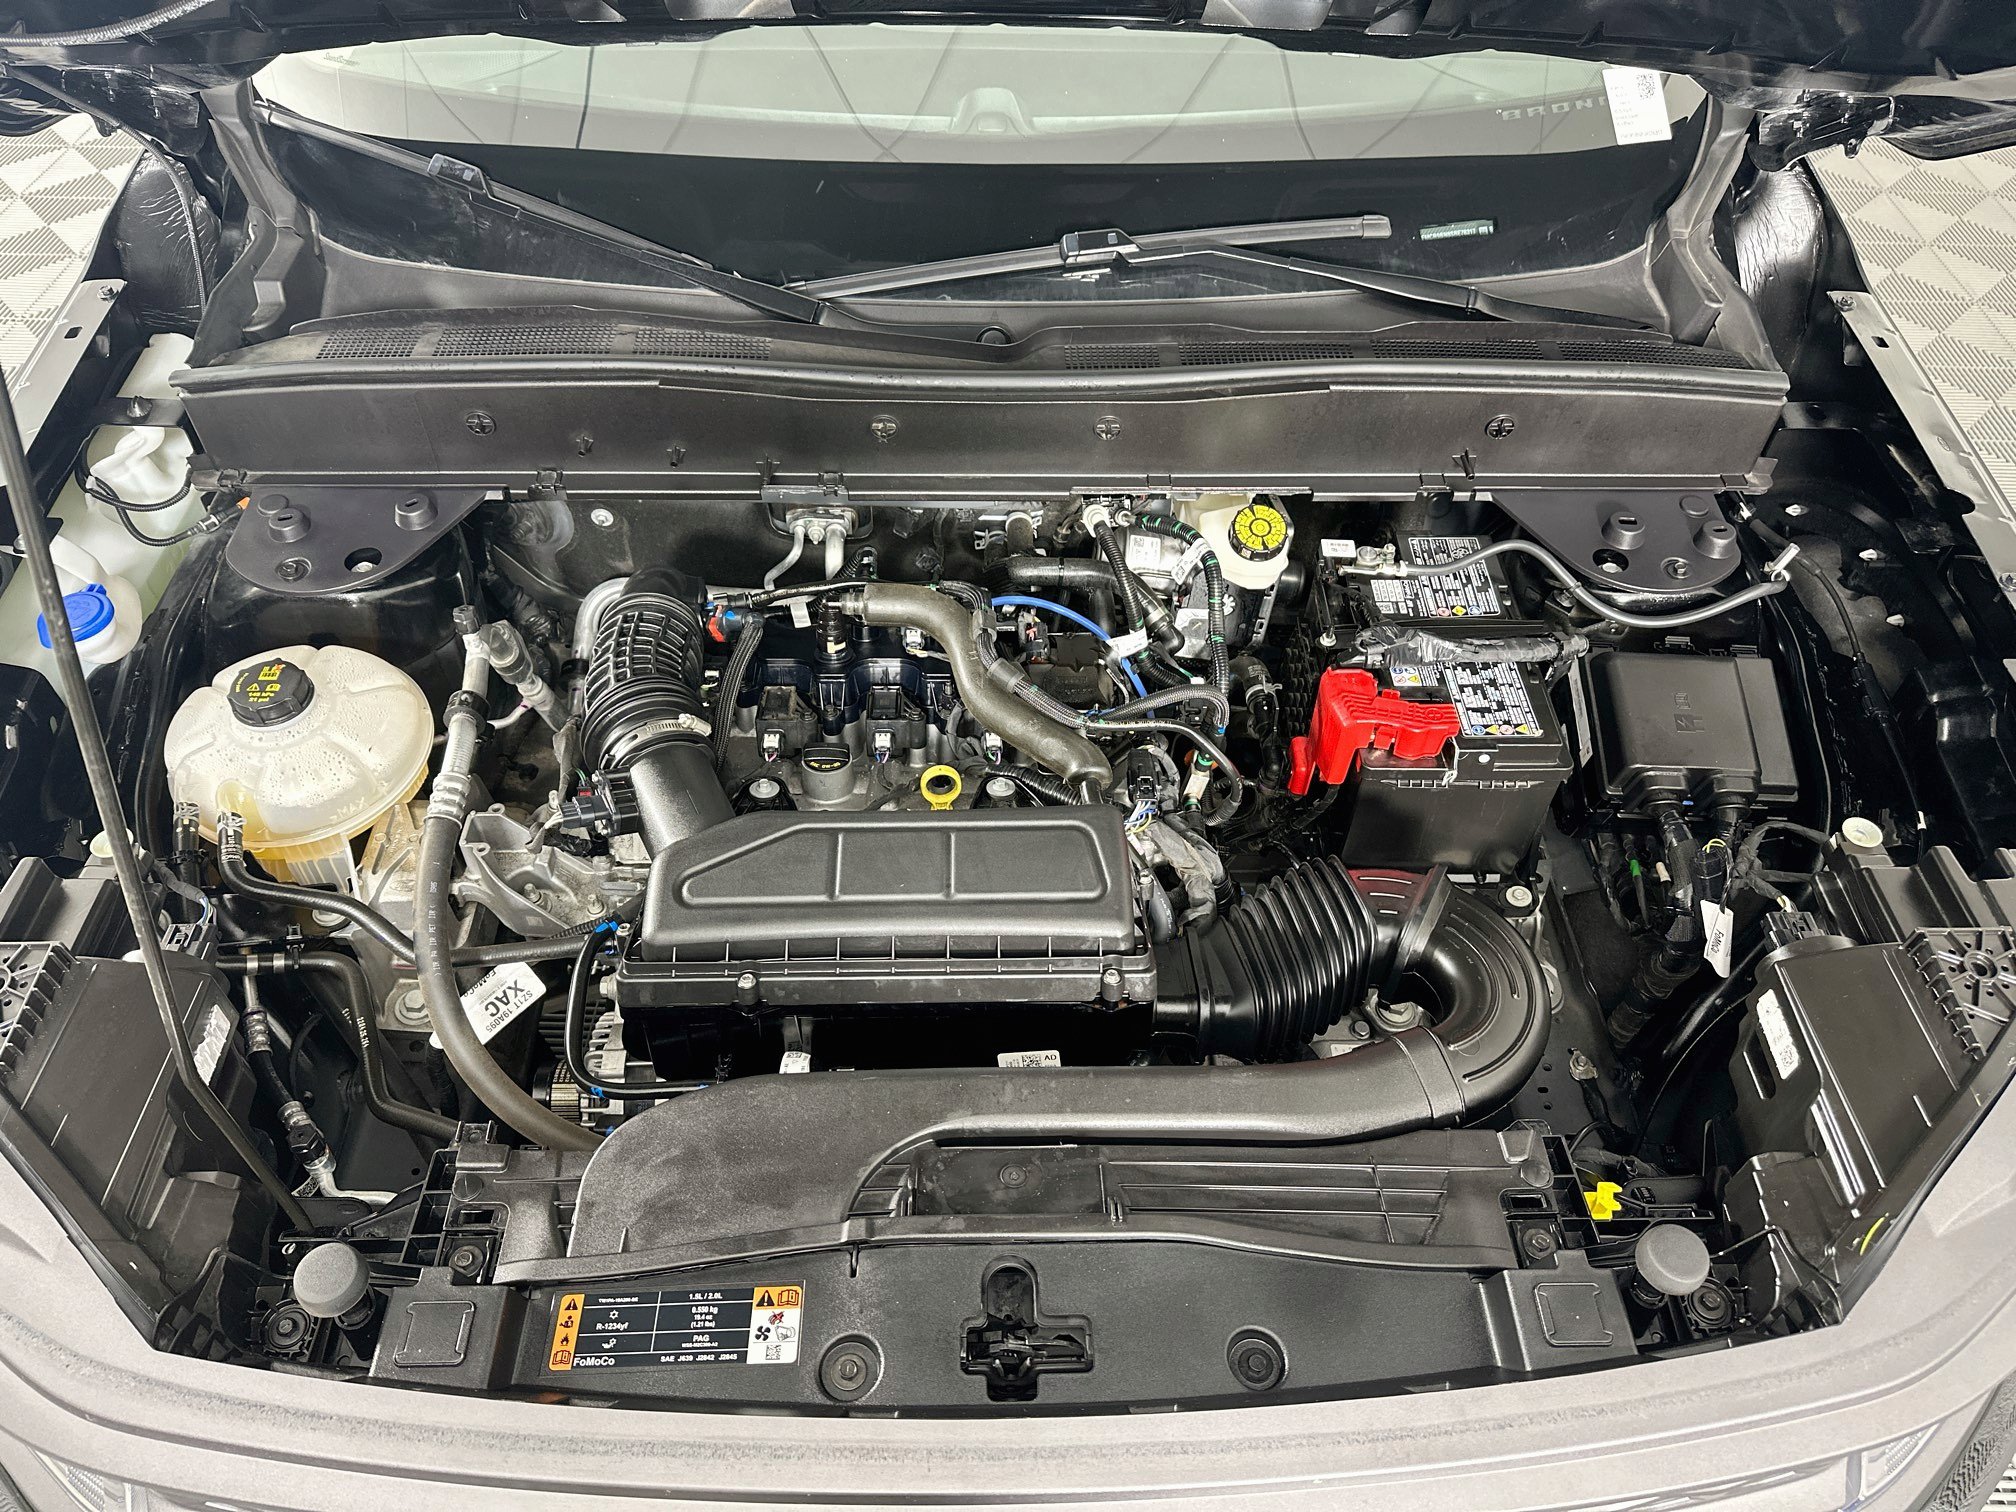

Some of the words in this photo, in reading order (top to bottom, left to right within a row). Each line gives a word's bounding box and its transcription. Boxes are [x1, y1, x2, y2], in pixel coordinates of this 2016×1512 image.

[484, 980, 525, 1017] XAC
[514, 990, 533, 1010] SZ1T
[485, 1008, 513, 1033] 19A095
[708, 1292, 723, 1300] 2.0L
[709, 1305, 719, 1315] kg
[596, 1322, 630, 1331] R-1234yf
[573, 1356, 616, 1367] FoMoCo
[677, 1354, 693, 1362] J639
